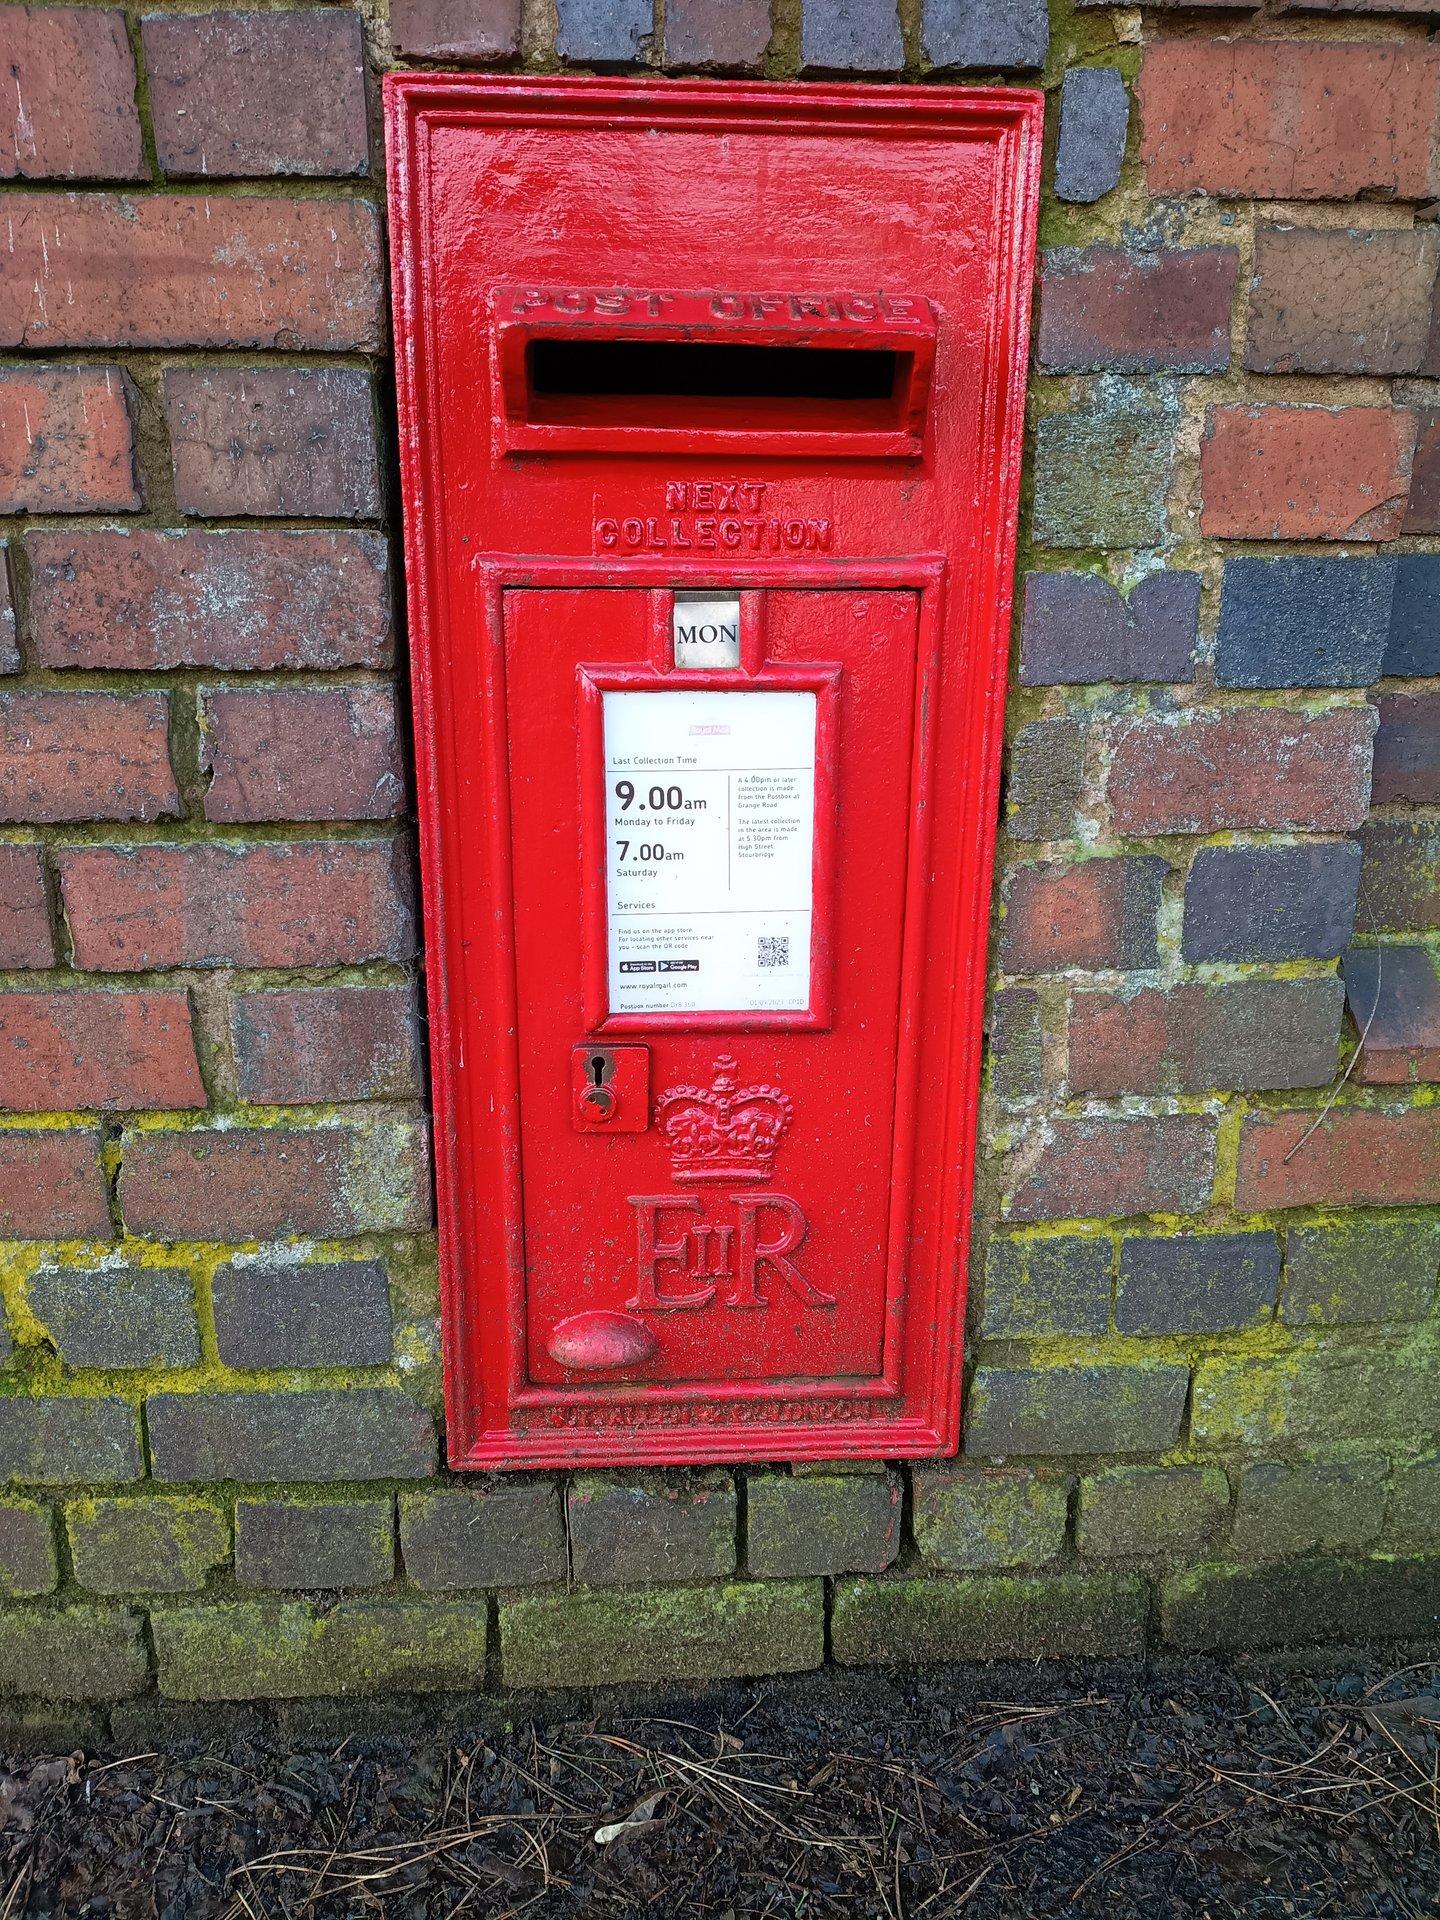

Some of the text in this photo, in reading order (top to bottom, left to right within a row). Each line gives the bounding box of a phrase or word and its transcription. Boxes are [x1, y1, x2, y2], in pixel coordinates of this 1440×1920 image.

[511, 288, 920, 323] POST OFFICE
[665, 480, 768, 513] NEXT
[595, 517, 834, 551] COLLECTION
[677, 625, 737, 644] MON
[615, 780, 707, 811] 9.00am
[615, 817, 695, 827] Monday to Friday
[616, 840, 684, 861] 7.00am
[616, 869, 658, 878] Saturday
[617, 901, 656, 910] Services
